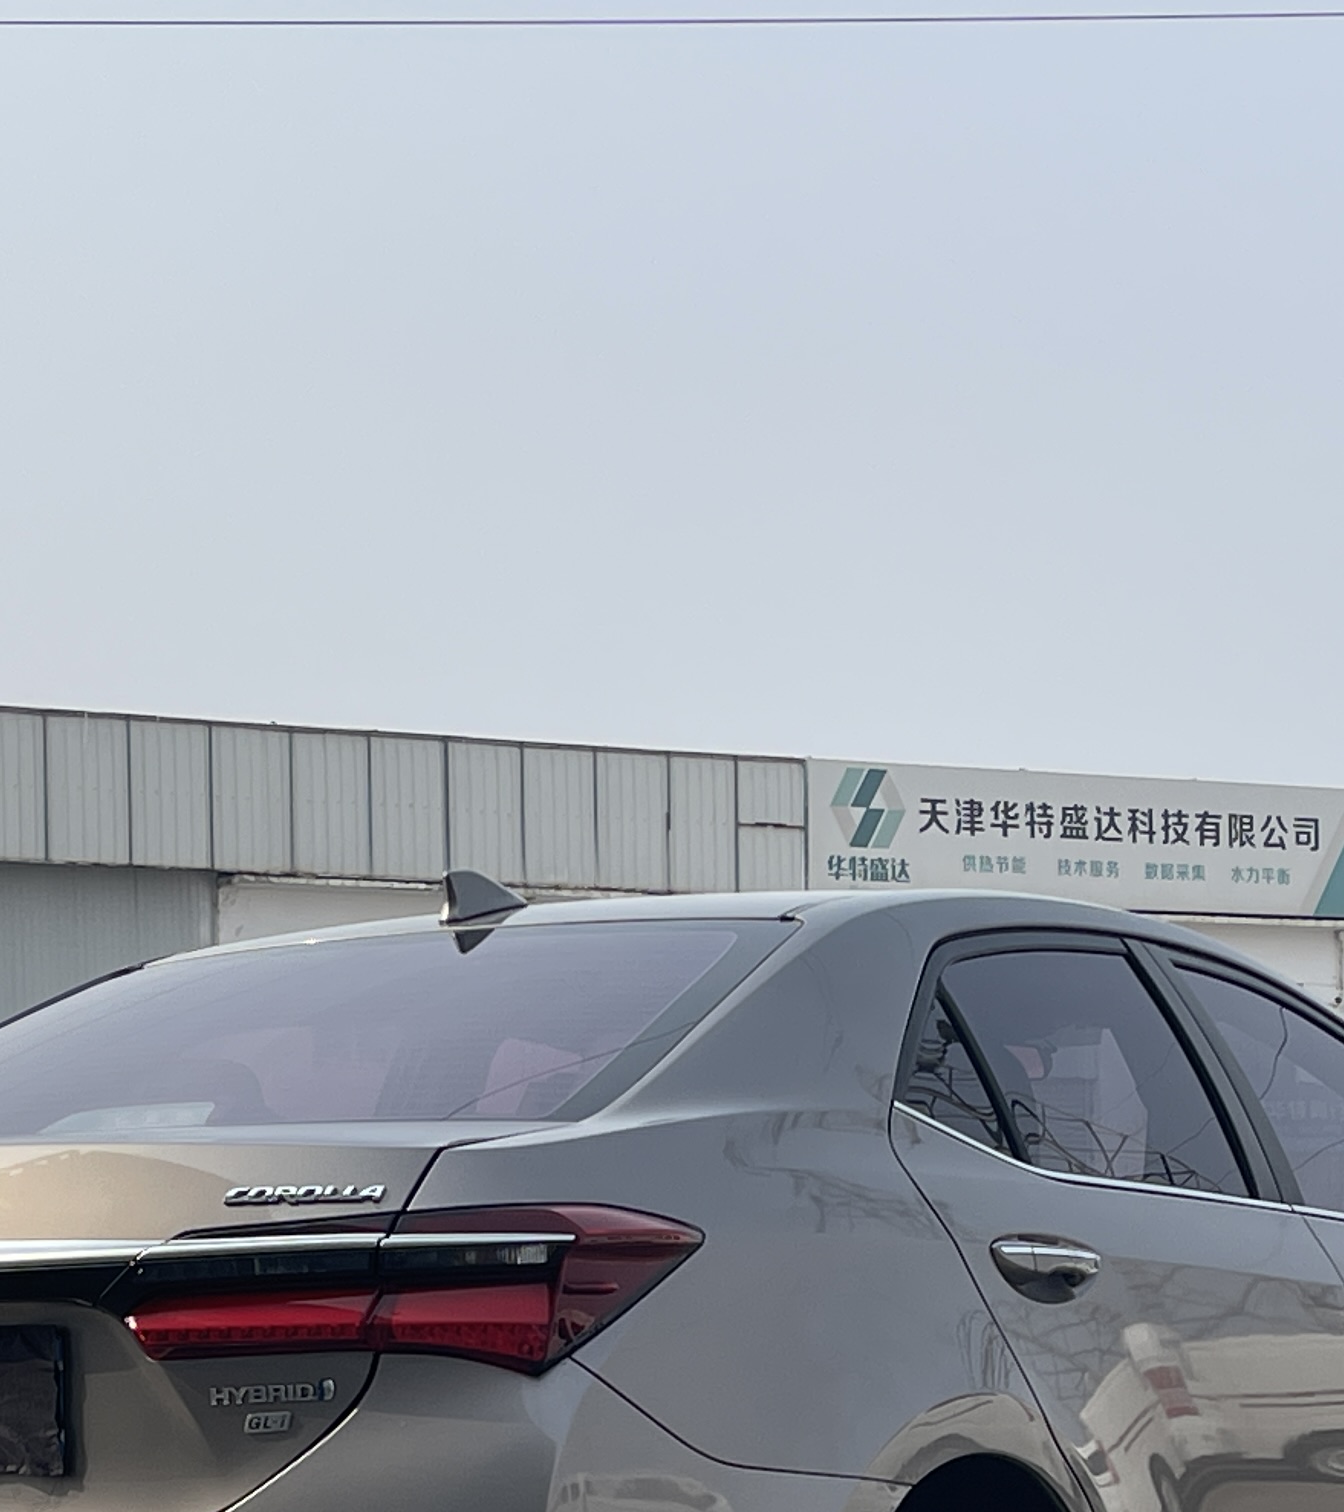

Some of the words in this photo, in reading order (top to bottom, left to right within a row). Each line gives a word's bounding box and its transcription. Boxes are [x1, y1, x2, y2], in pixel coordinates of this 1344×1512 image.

[919, 797, 1320, 851] 天津华特盛达科技有限公司
[827, 855, 911, 883] 华特盛达
[962, 855, 1027, 874] 供热节能
[1057, 858, 1120, 878] 技术服务
[1145, 862, 1206, 881] 数据采集
[1231, 866, 1291, 885] 水力平衡
[224, 1184, 387, 1206] COROLLA
[209, 1383, 317, 1406] HYBRID
